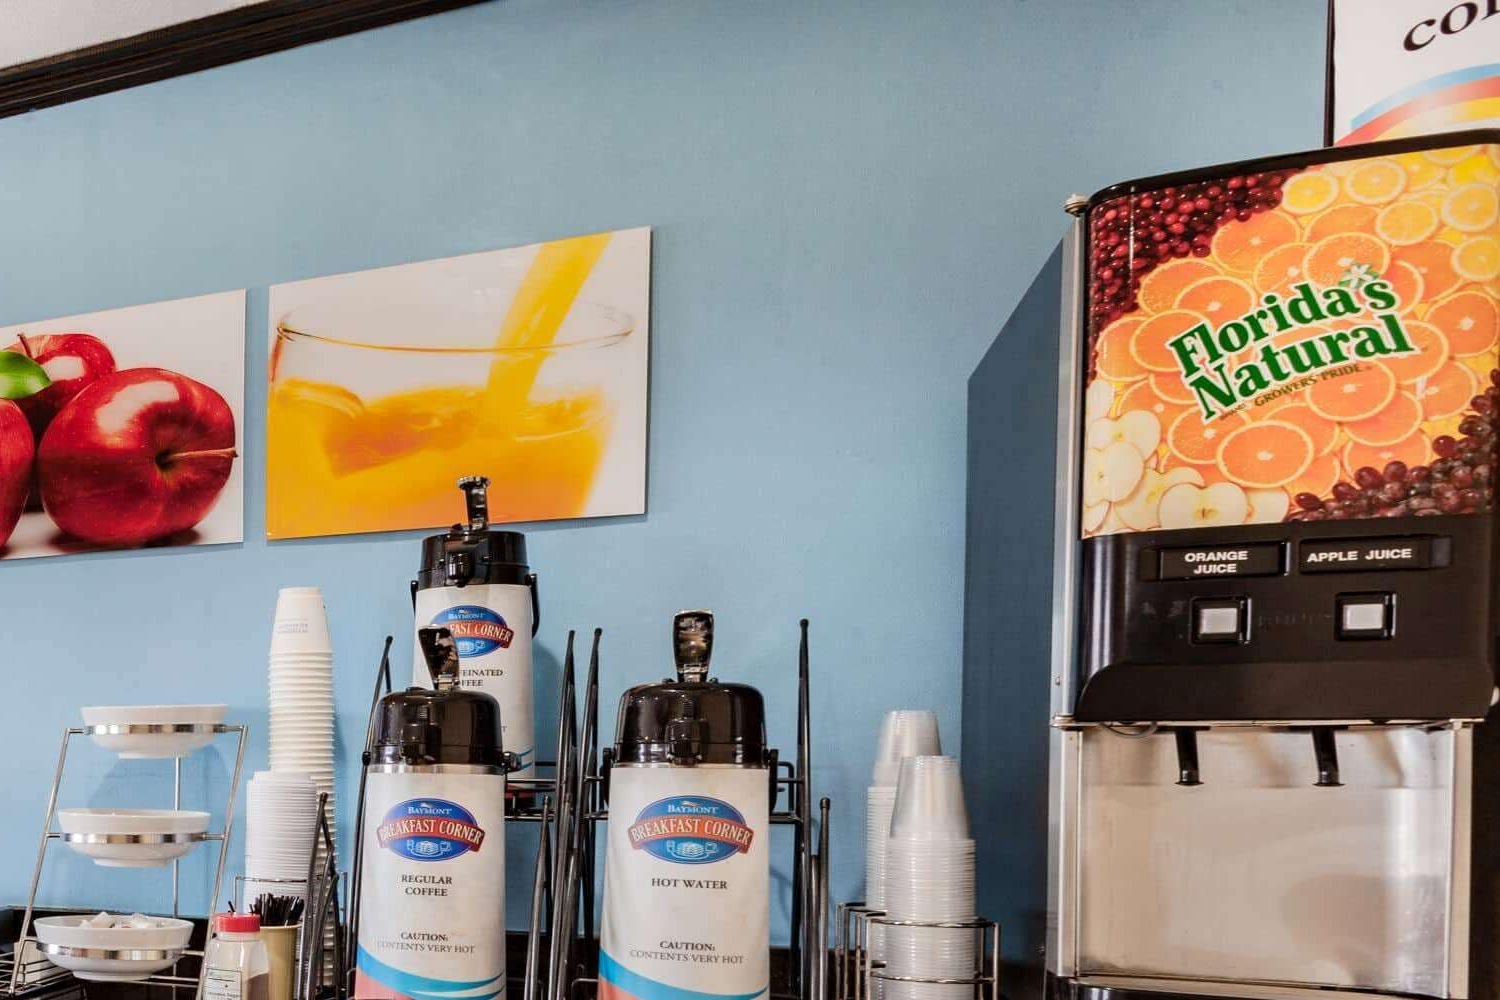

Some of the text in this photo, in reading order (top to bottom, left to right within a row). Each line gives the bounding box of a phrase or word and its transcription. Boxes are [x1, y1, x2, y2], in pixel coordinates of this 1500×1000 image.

[1190, 314, 1415, 419] Natural
[1320, 364, 1363, 381] PRIDE
[1184, 550, 1248, 563] ORANGE
[1307, 548, 1412, 563] APPLE JUICE
[1193, 563, 1237, 575] JUICE
[474, 623, 511, 642] CORNER
[408, 806, 451, 815] BAYMONT
[667, 804, 717, 814] BAYMONT
[379, 818, 481, 845] BREAKFAST CORNER
[631, 818, 750, 846] BREAKFAST CORNER
[401, 874, 452, 885] REGULAR
[651, 877, 728, 890] HOT WATER
[405, 887, 448, 897] COFFEE
[400, 931, 449, 942] CAUTION:
[377, 941, 476, 954] CONTENTS VERY HOT
[659, 940, 716, 951] CAUTION:
[629, 949, 744, 965] CONTENTS VERY HOT
